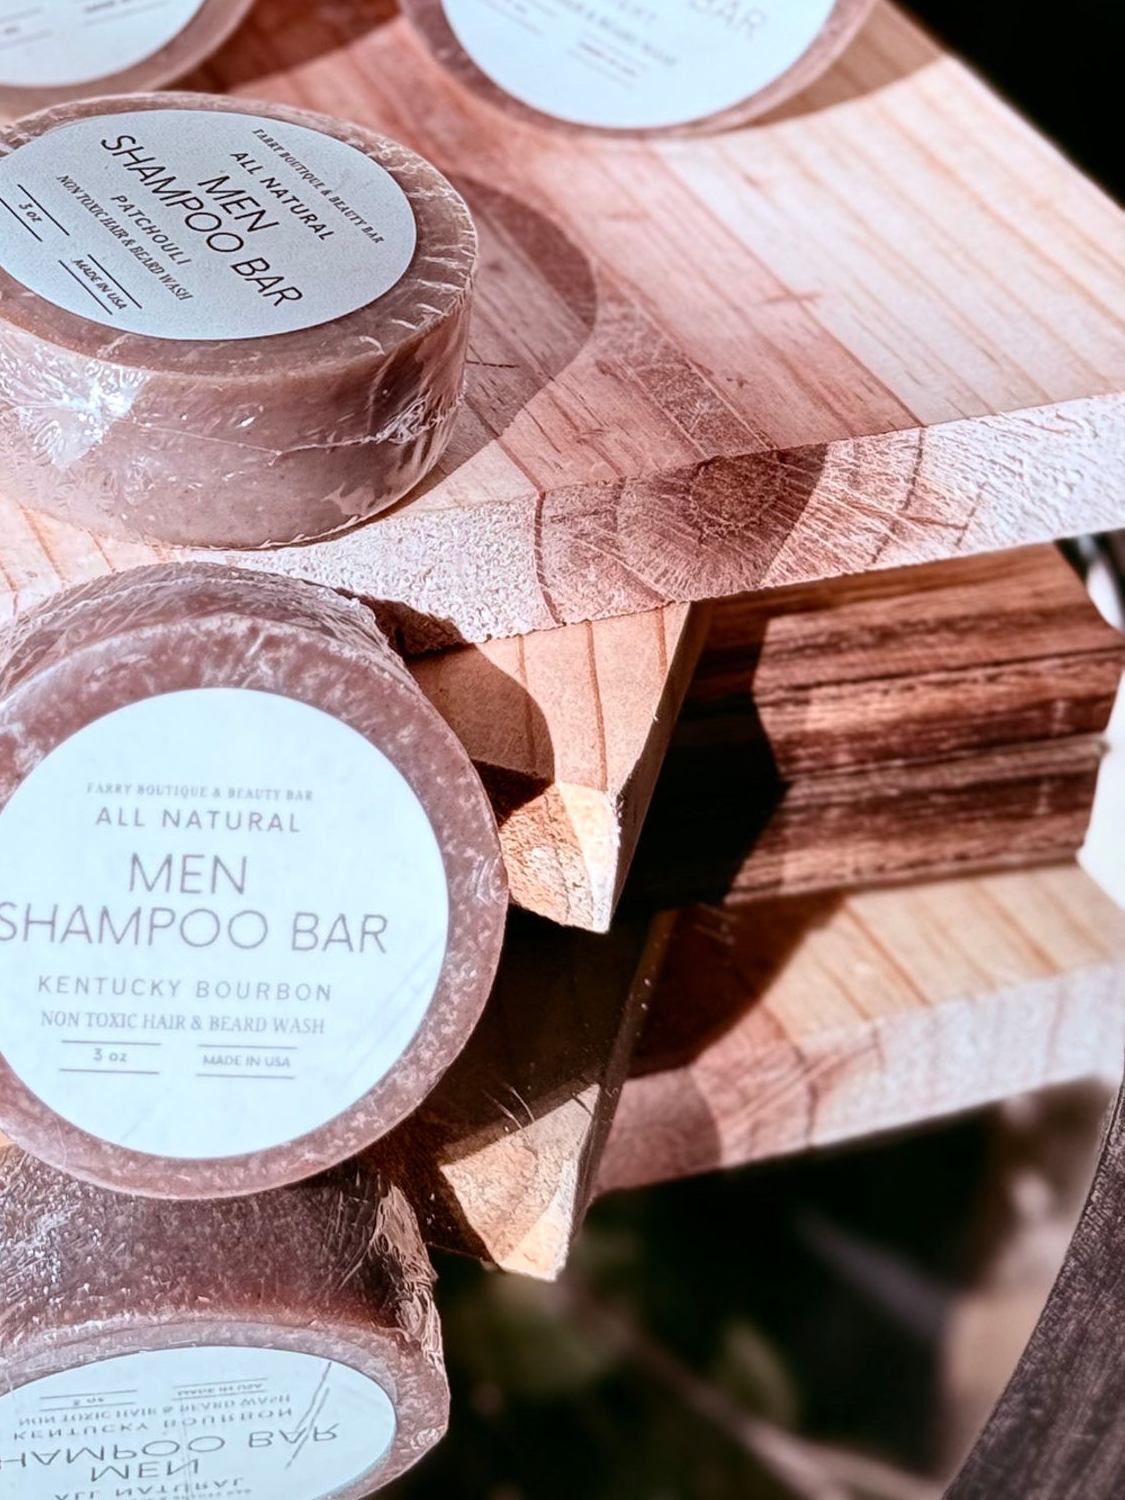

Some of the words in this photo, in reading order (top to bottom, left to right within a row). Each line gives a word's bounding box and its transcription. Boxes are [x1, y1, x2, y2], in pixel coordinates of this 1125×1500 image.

[56, 175, 81, 195] NON
[230, 151, 264, 175] ALL
[260, 177, 336, 241] NATURAL
[252, 128, 284, 152] FARRY
[279, 151, 325, 190] BOUTIQUE
[321, 189, 333, 197] &
[329, 196, 368, 227] BEAUTY
[361, 225, 385, 244] BAR
[18, 202, 34, 211] 3
[26, 211, 44, 223] oz
[76, 192, 107, 219] TOXIC
[197, 174, 279, 234] MEN
[99, 217, 129, 239] HAIR
[100, 134, 245, 253] SHAMPOO
[230, 256, 304, 307] BAR
[110, 195, 192, 265] PATCHOULI
[123, 238, 136, 248] &
[129, 245, 165, 274] BEARD
[72, 259, 103, 283] MADE
[96, 281, 112, 293] IN
[107, 292, 127, 310] USA
[159, 273, 194, 301] WASH
[86, 781, 132, 796] FARRY
[137, 784, 208, 799] BOUTIQUE
[212, 786, 222, 798] &
[228, 787, 281, 800] BEAUTY
[286, 789, 313, 801] BAR
[95, 806, 145, 827] ALL
[161, 808, 300, 833] NATURAL
[128, 852, 248, 896] MEN
[291, 911, 389, 955] BAR
[37, 975, 181, 997] KENTUCKY
[195, 980, 332, 1002] BOURBON
[41, 1010, 79, 1027] NON
[86, 1011, 137, 1029] TOXIC
[143, 1013, 186, 1031] HAIR
[191, 1014, 203, 1031] &
[209, 1015, 267, 1033] BEARD
[274, 1017, 325, 1035] WASH
[93, 1047, 103, 1062] 3
[108, 1050, 128, 1062] oz
[203, 1054, 242, 1067] MADE
[246, 1055, 261, 1067] IN
[265, 1056, 291, 1068] USA
